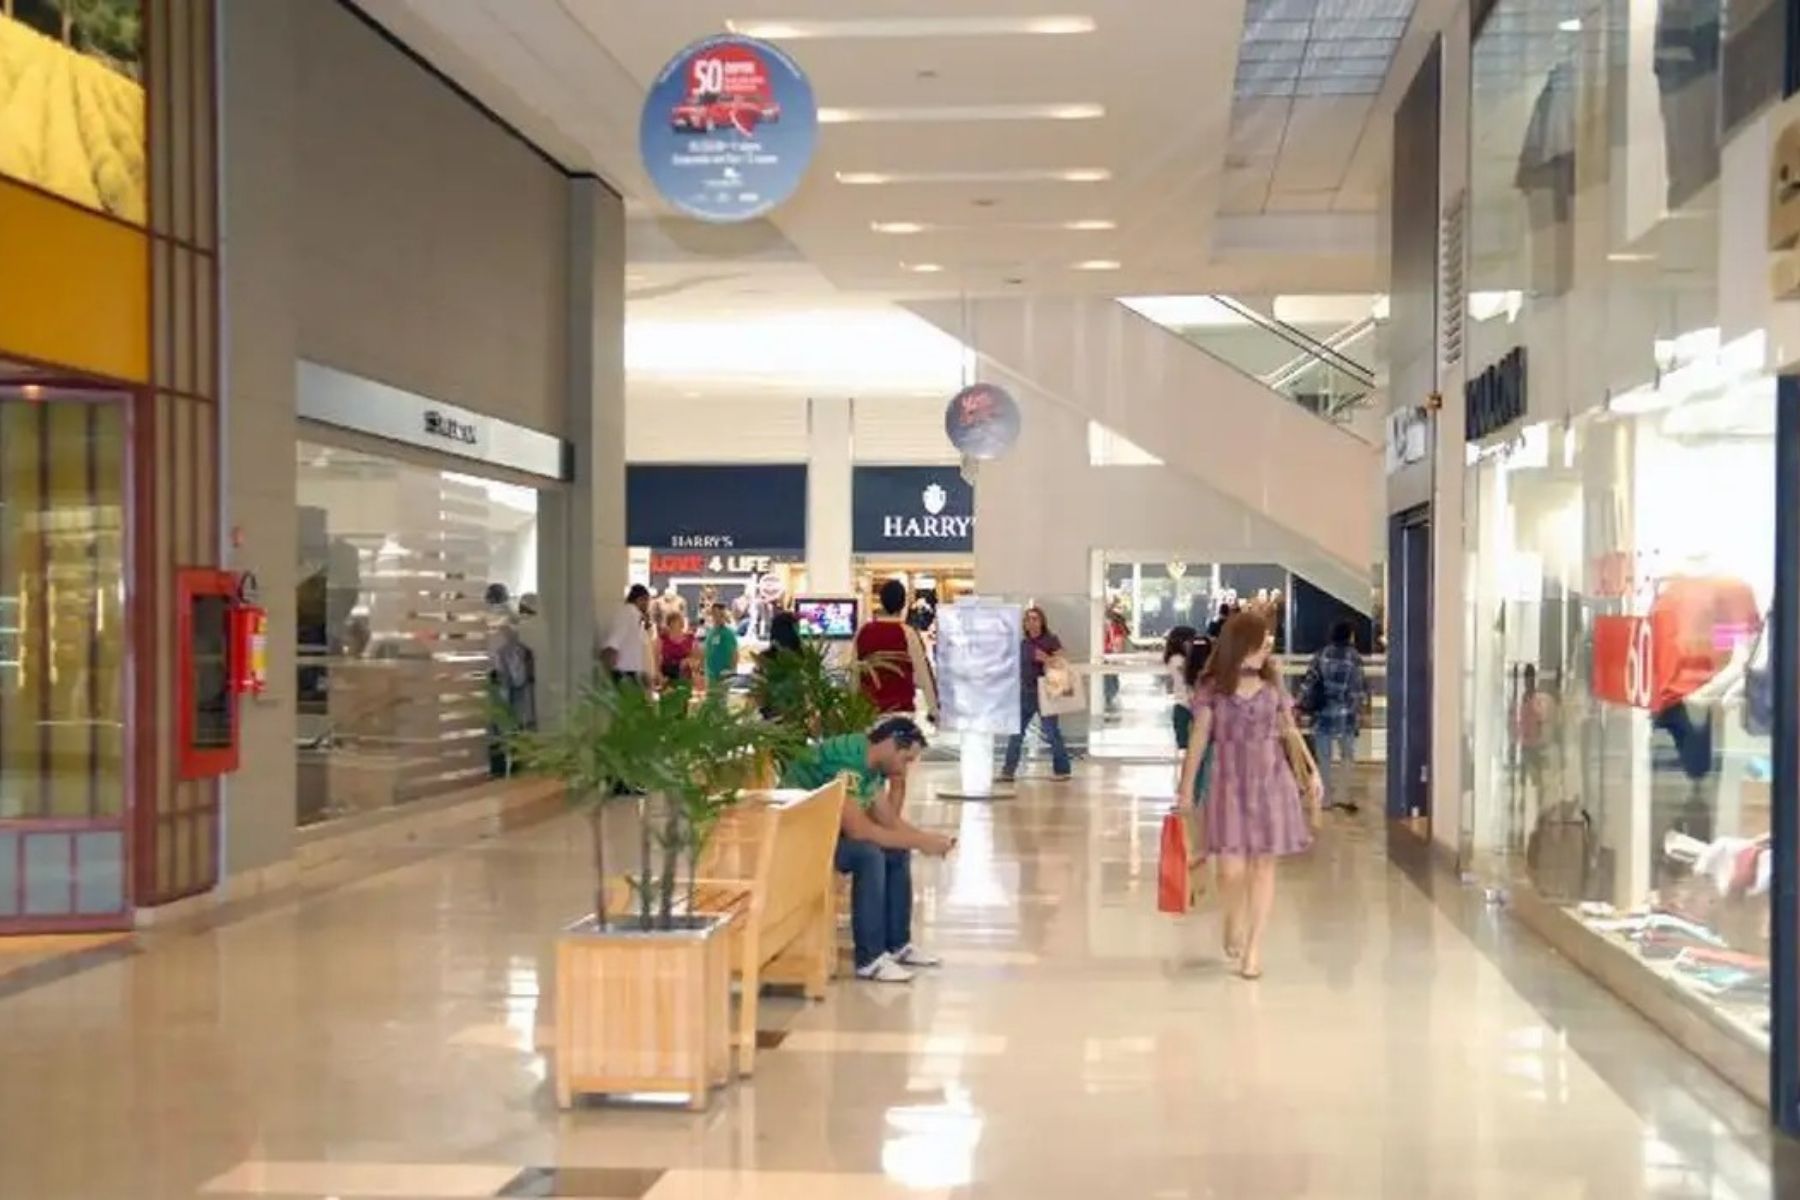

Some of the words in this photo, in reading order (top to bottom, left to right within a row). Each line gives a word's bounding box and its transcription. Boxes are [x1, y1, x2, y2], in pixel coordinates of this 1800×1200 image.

[692, 59, 723, 95] 50
[671, 535, 734, 548] HARRY'S
[652, 554, 704, 574] LOVE
[708, 555, 723, 573] 4
[727, 555, 772, 573] LIFE
